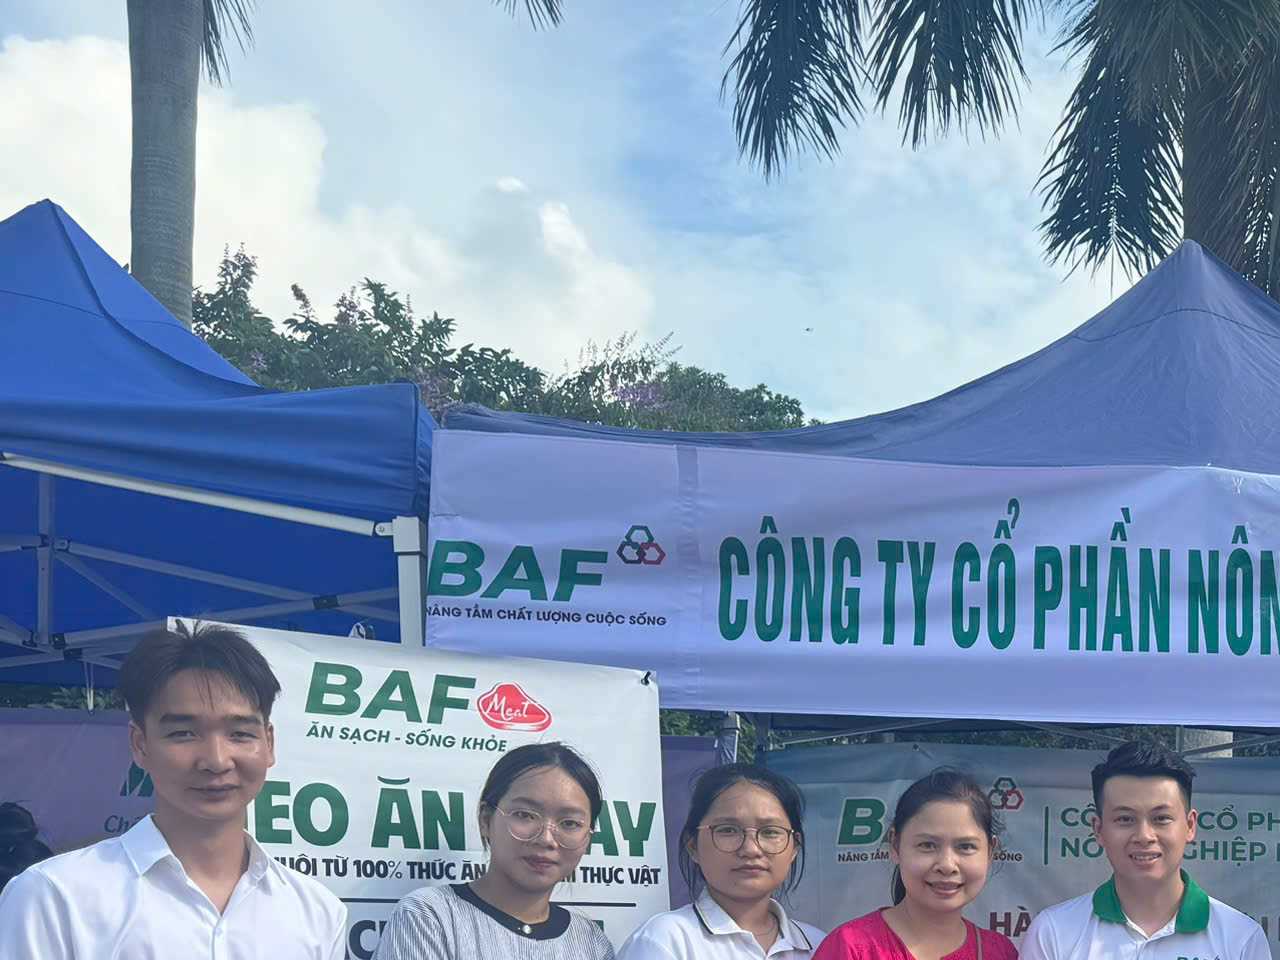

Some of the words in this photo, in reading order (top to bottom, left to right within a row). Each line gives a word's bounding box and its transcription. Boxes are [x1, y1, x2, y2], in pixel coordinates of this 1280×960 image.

[427, 539, 608, 602] BAF
[718, 515, 862, 645] CÔNG
[877, 539, 936, 647] TY
[951, 497, 1021, 651] CỔ
[1033, 507, 1171, 654] PHẦN
[465, 603, 493, 620] TẦM
[497, 606, 533, 622] CHẤT
[536, 610, 582, 626] LƯỢNG
[585, 612, 625, 627] CUỘC
[629, 613, 667, 627] SỐNG
[305, 661, 477, 726] BAF
[484, 692, 530, 722] Meat
[306, 721, 335, 740] ĂN
[339, 726, 391, 745] SẠCH
[405, 728, 456, 749] SỐNG
[461, 734, 507, 752] KHỎE
[249, 780, 349, 847] EO
[371, 775, 466, 851] ĂN
[585, 799, 657, 858] AY
[1060, 803, 1099, 827] CÔ
[1060, 833, 1104, 858] NÔ
[1183, 836, 1267, 868] GHIỆP
[322, 855, 349, 878] TỪ
[353, 858, 403, 880] 100%
[406, 857, 456, 881] THỨC
[580, 865, 625, 885] THỰC
[628, 866, 662, 887] VẬT
